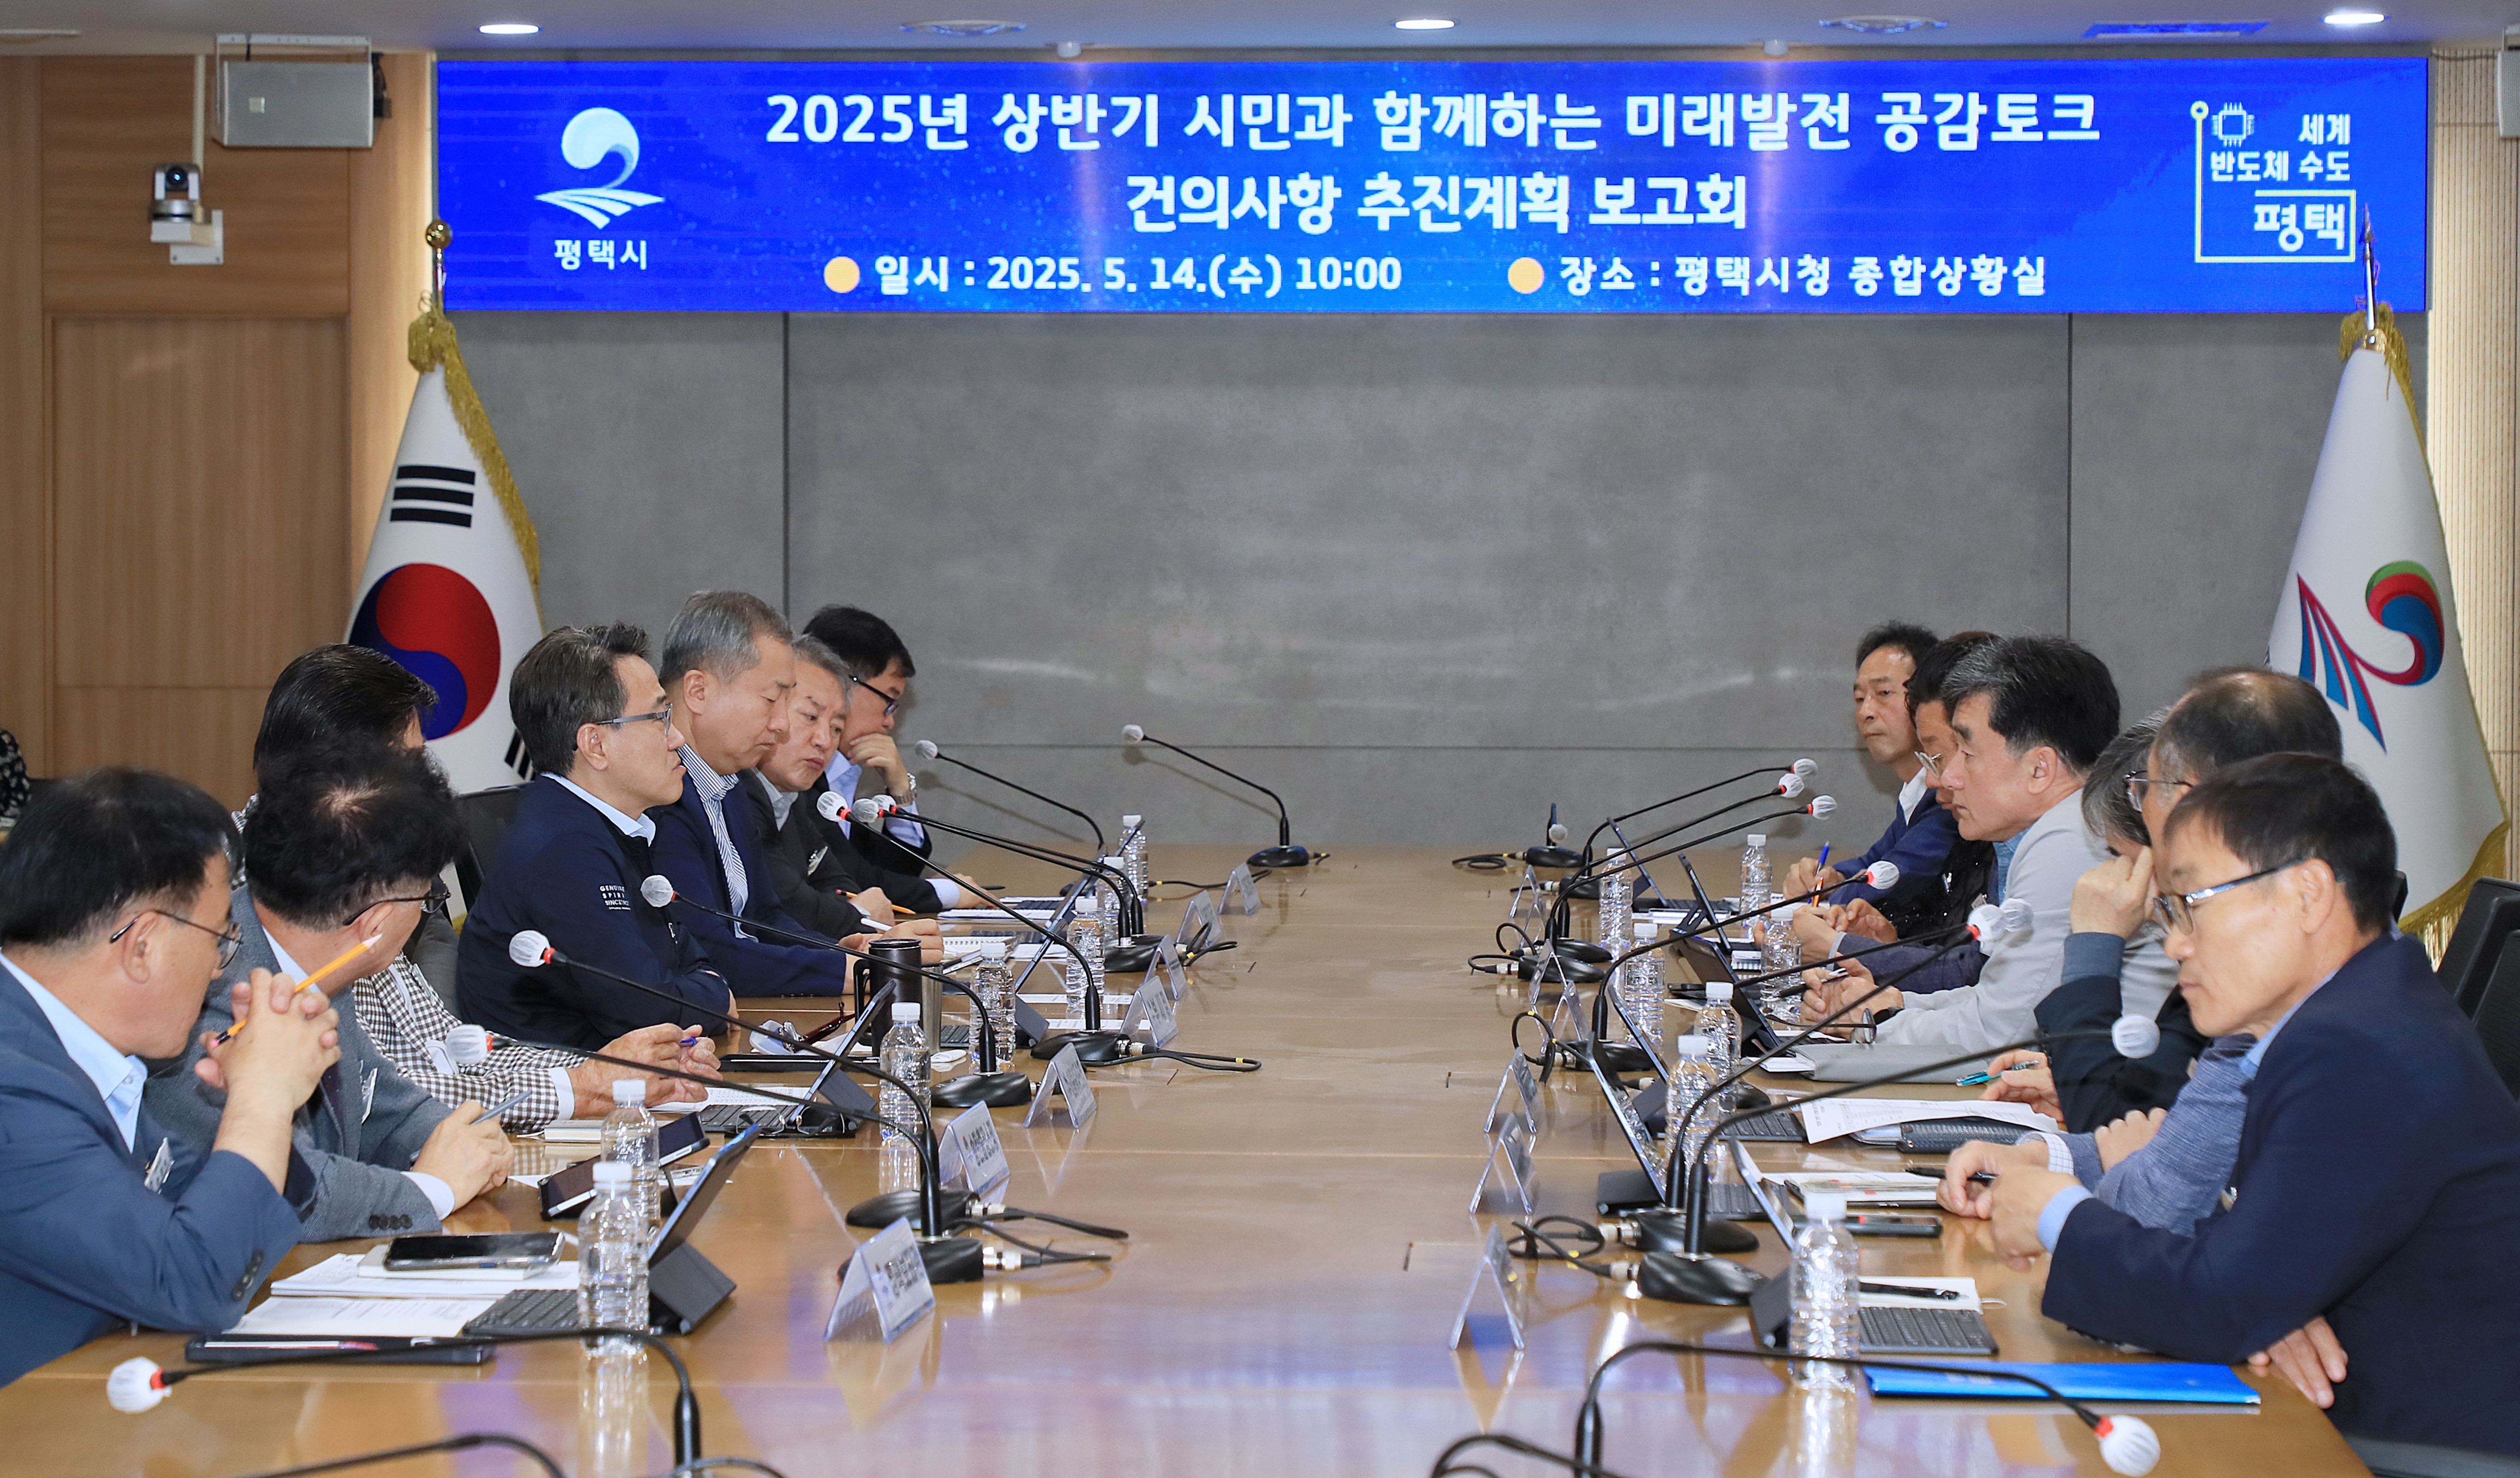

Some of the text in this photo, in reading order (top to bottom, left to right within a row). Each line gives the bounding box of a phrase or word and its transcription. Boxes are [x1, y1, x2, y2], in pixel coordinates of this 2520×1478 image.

[767, 91, 2101, 152] 2025년 상반기 시민과 함께하는 미래발전 공감토크
[2299, 114, 2351, 145] 세계
[2211, 150, 2350, 181] 반도체 수도
[1126, 172, 1747, 234] 건의사항 추진계획 보고회
[2254, 204, 2345, 252] 평택
[554, 239, 647, 270] 평택시
[875, 256, 949, 295] 일시
[987, 256, 1092, 292] 2025.
[1104, 258, 1137, 292] 5.
[1150, 254, 1282, 298] 14.(수)
[1296, 257, 1403, 289] 10:00
[1560, 257, 1636, 296] 장소
[1675, 256, 1830, 296] 평택시청
[1849, 254, 2046, 296] 종합상황실
